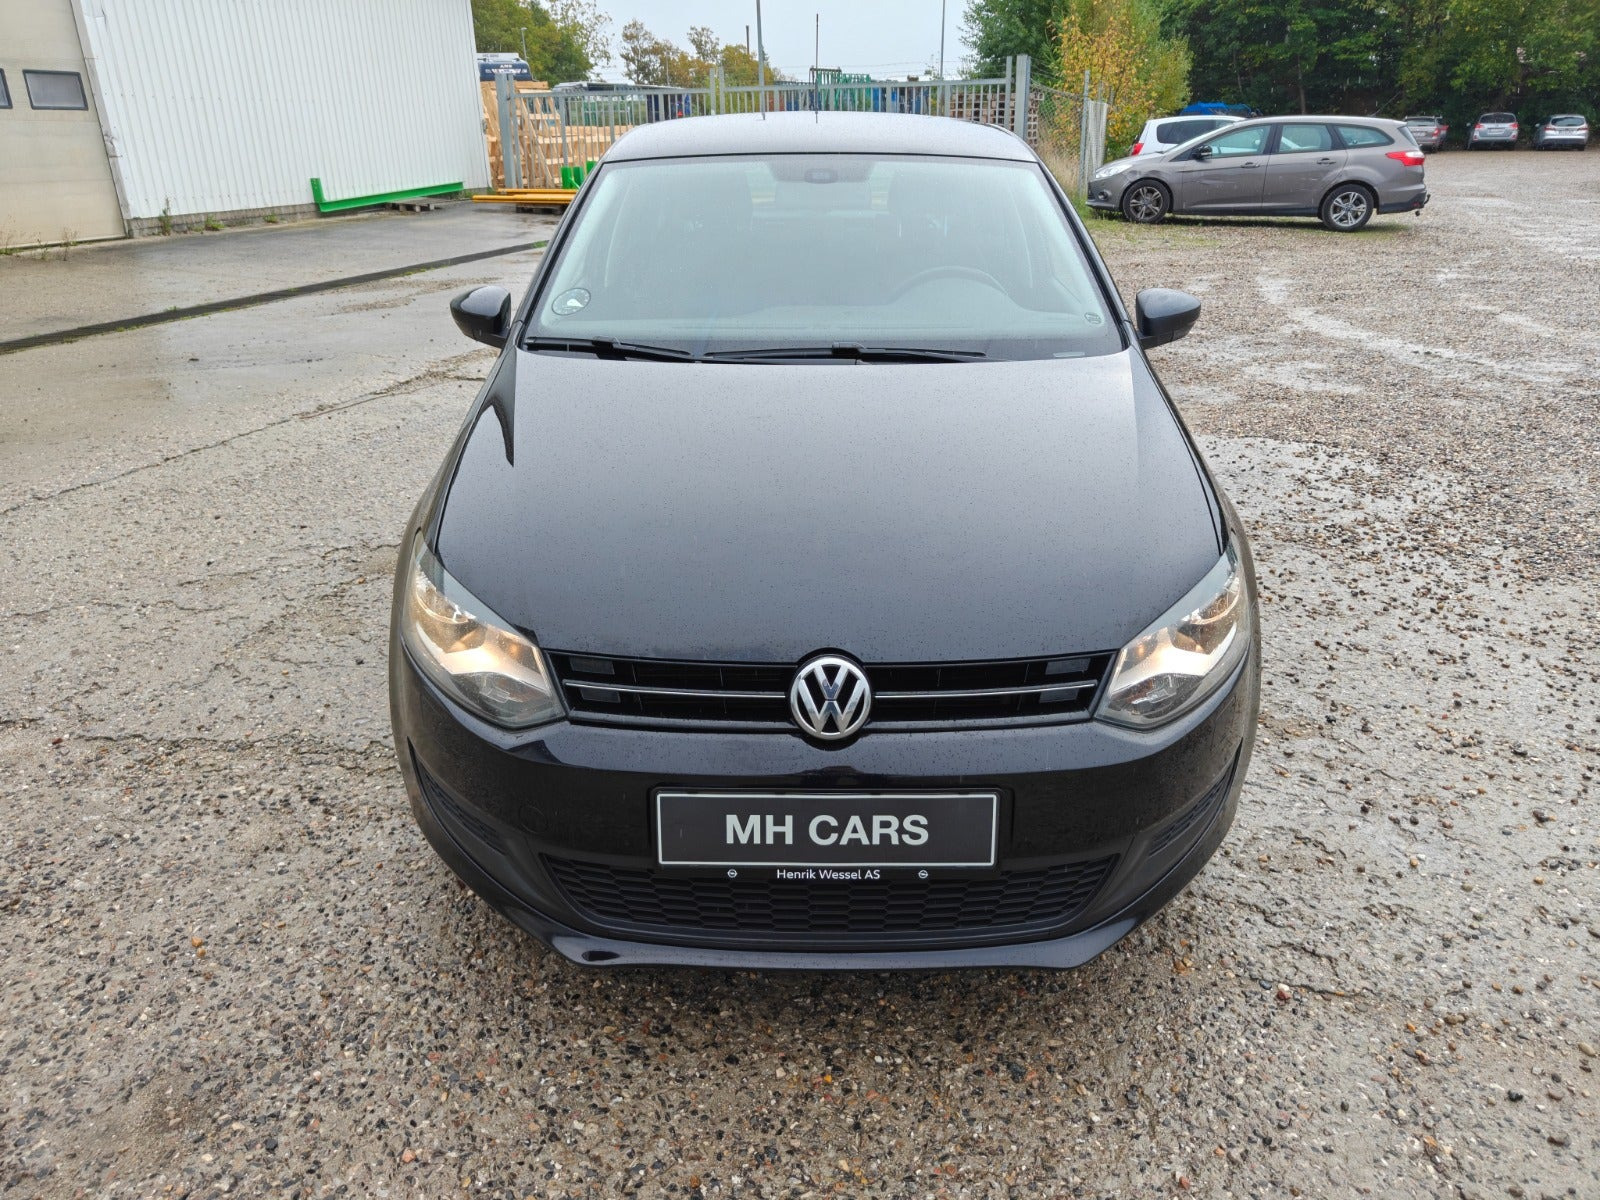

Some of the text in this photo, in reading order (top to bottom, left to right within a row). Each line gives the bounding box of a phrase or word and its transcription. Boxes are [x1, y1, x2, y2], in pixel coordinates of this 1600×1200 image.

[725, 814, 929, 846] MH CARS
[776, 868, 881, 880] Henrik Wessel AS
